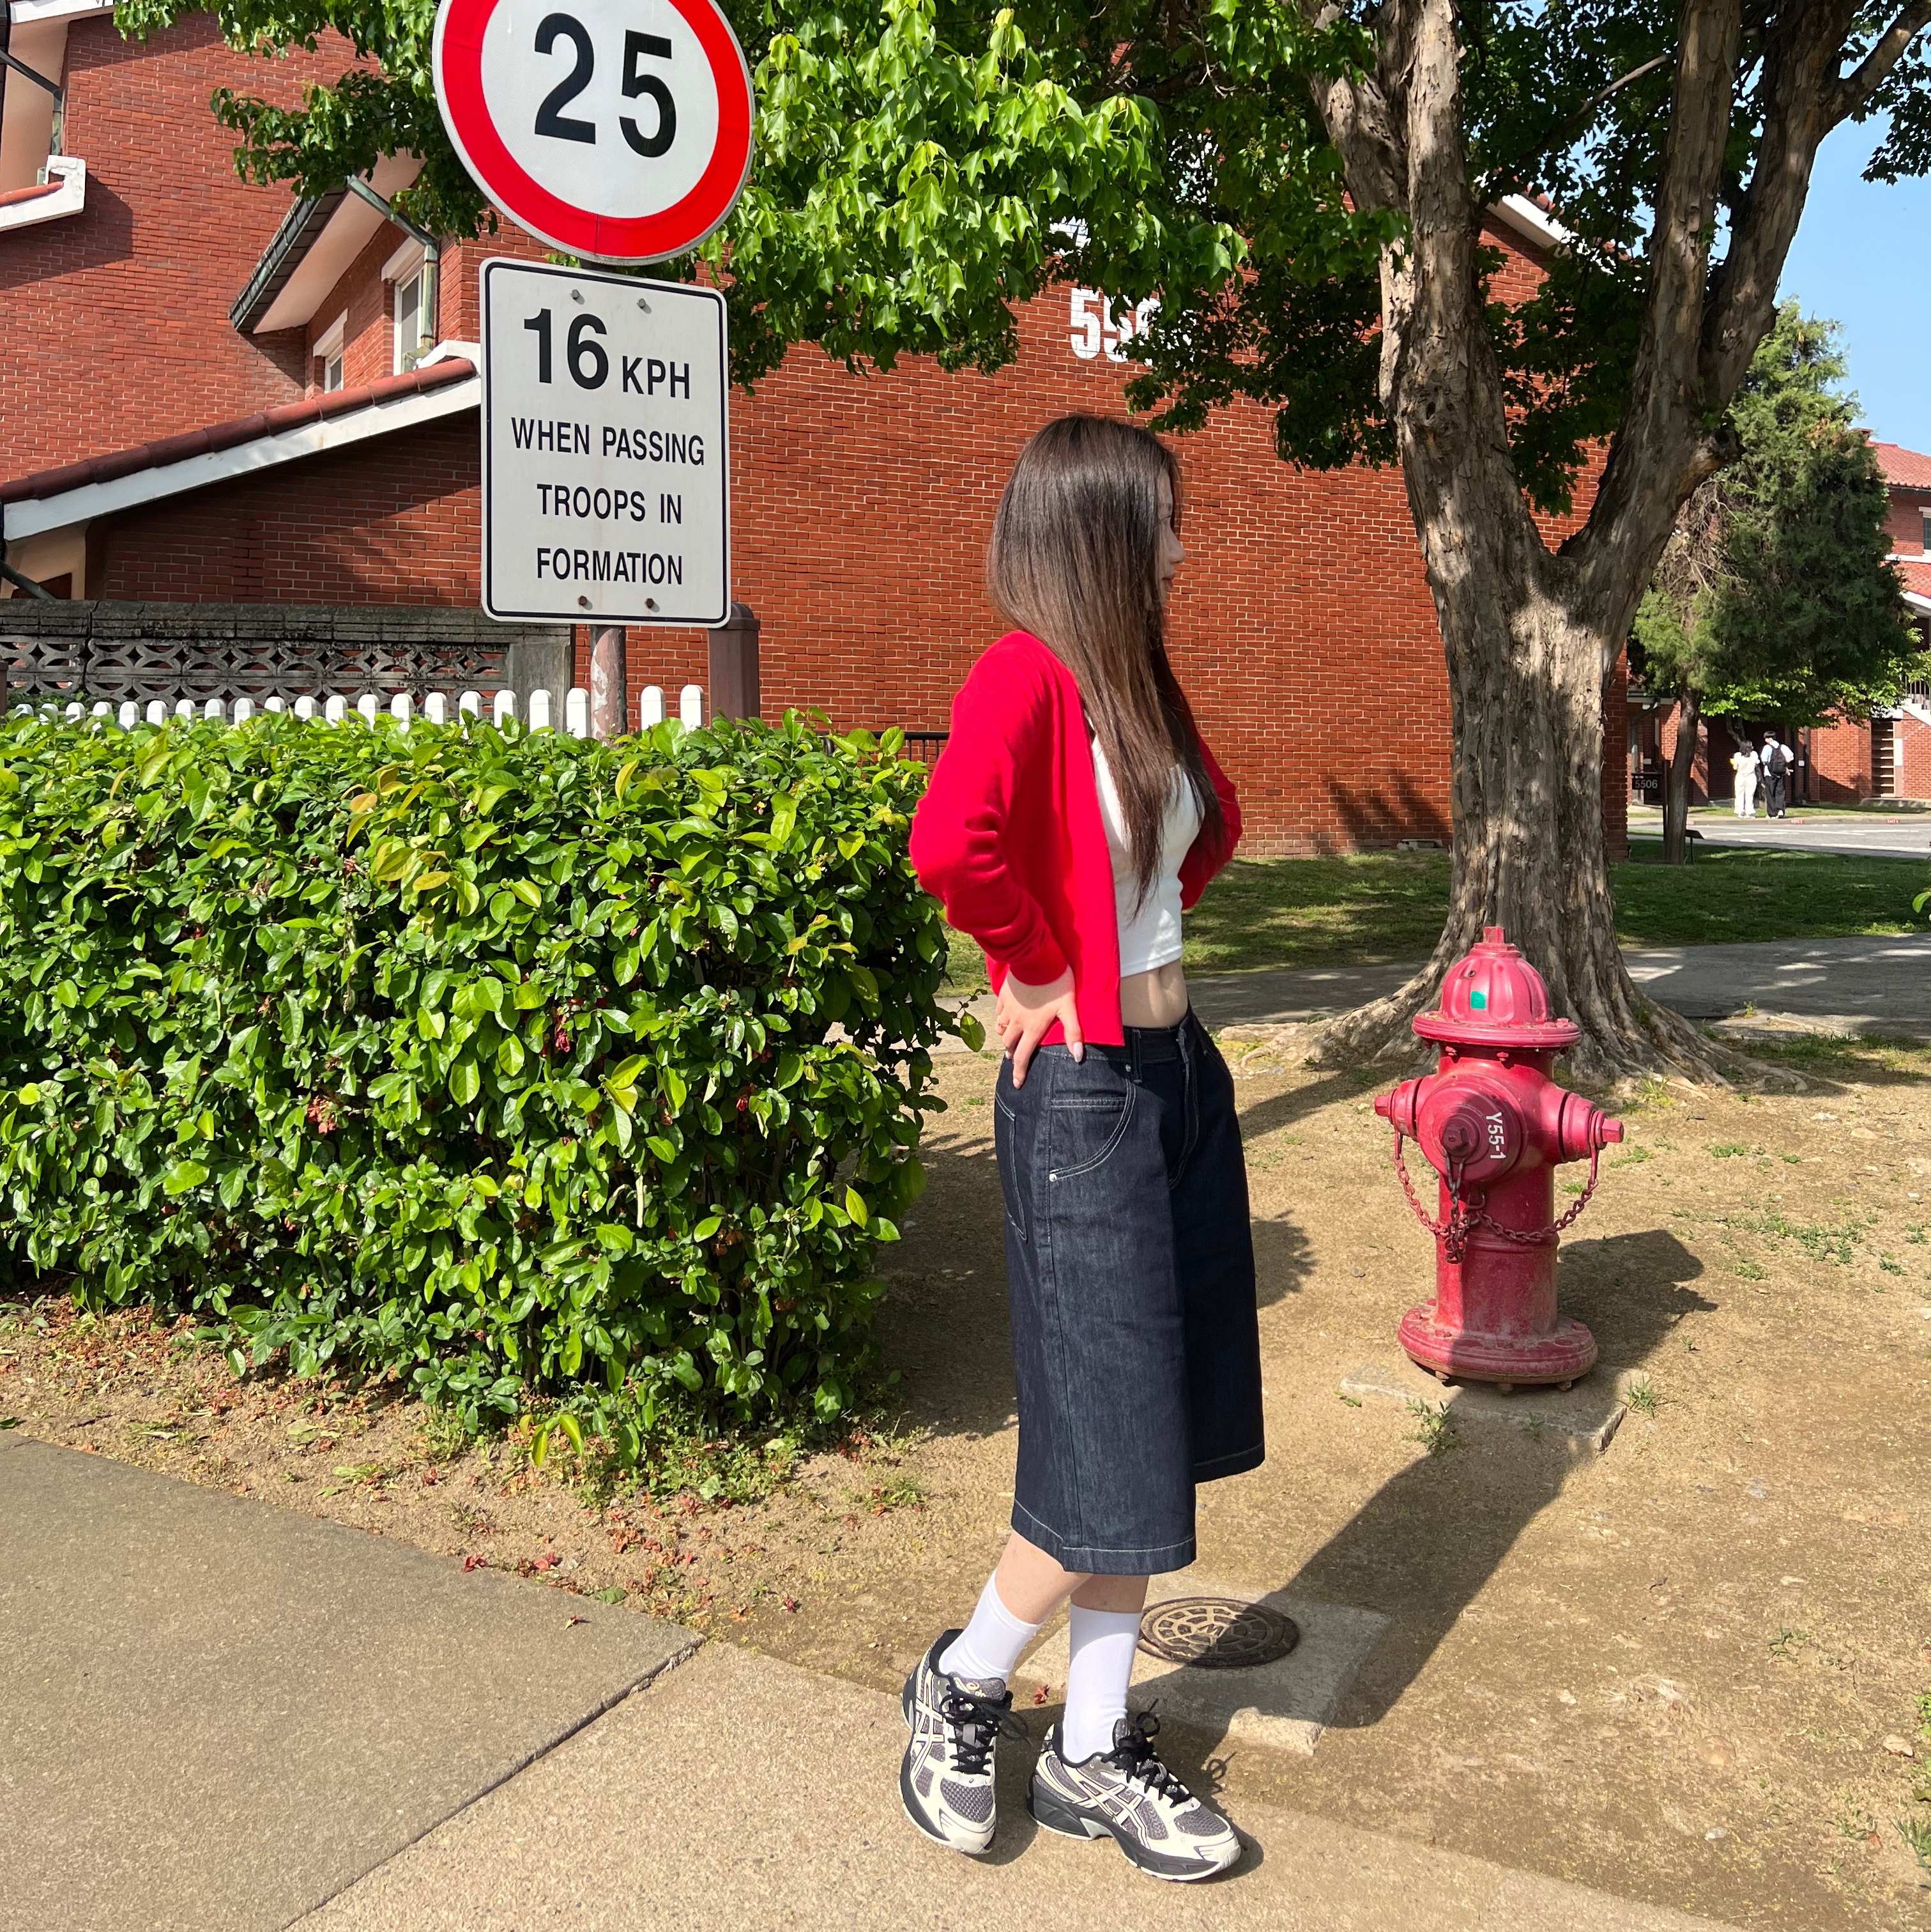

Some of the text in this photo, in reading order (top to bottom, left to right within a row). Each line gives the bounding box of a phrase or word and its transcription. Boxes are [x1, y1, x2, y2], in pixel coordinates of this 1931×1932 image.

[534, 13, 676, 158] 25
[524, 308, 690, 399] 16 KPH
[511, 417, 704, 466] WHEN PASSING
[537, 483, 682, 525] TROOPS IN
[537, 547, 682, 585] FORMATION
[1635, 779, 1658, 789] 5506
[1486, 1112, 1506, 1159] Y55-1
